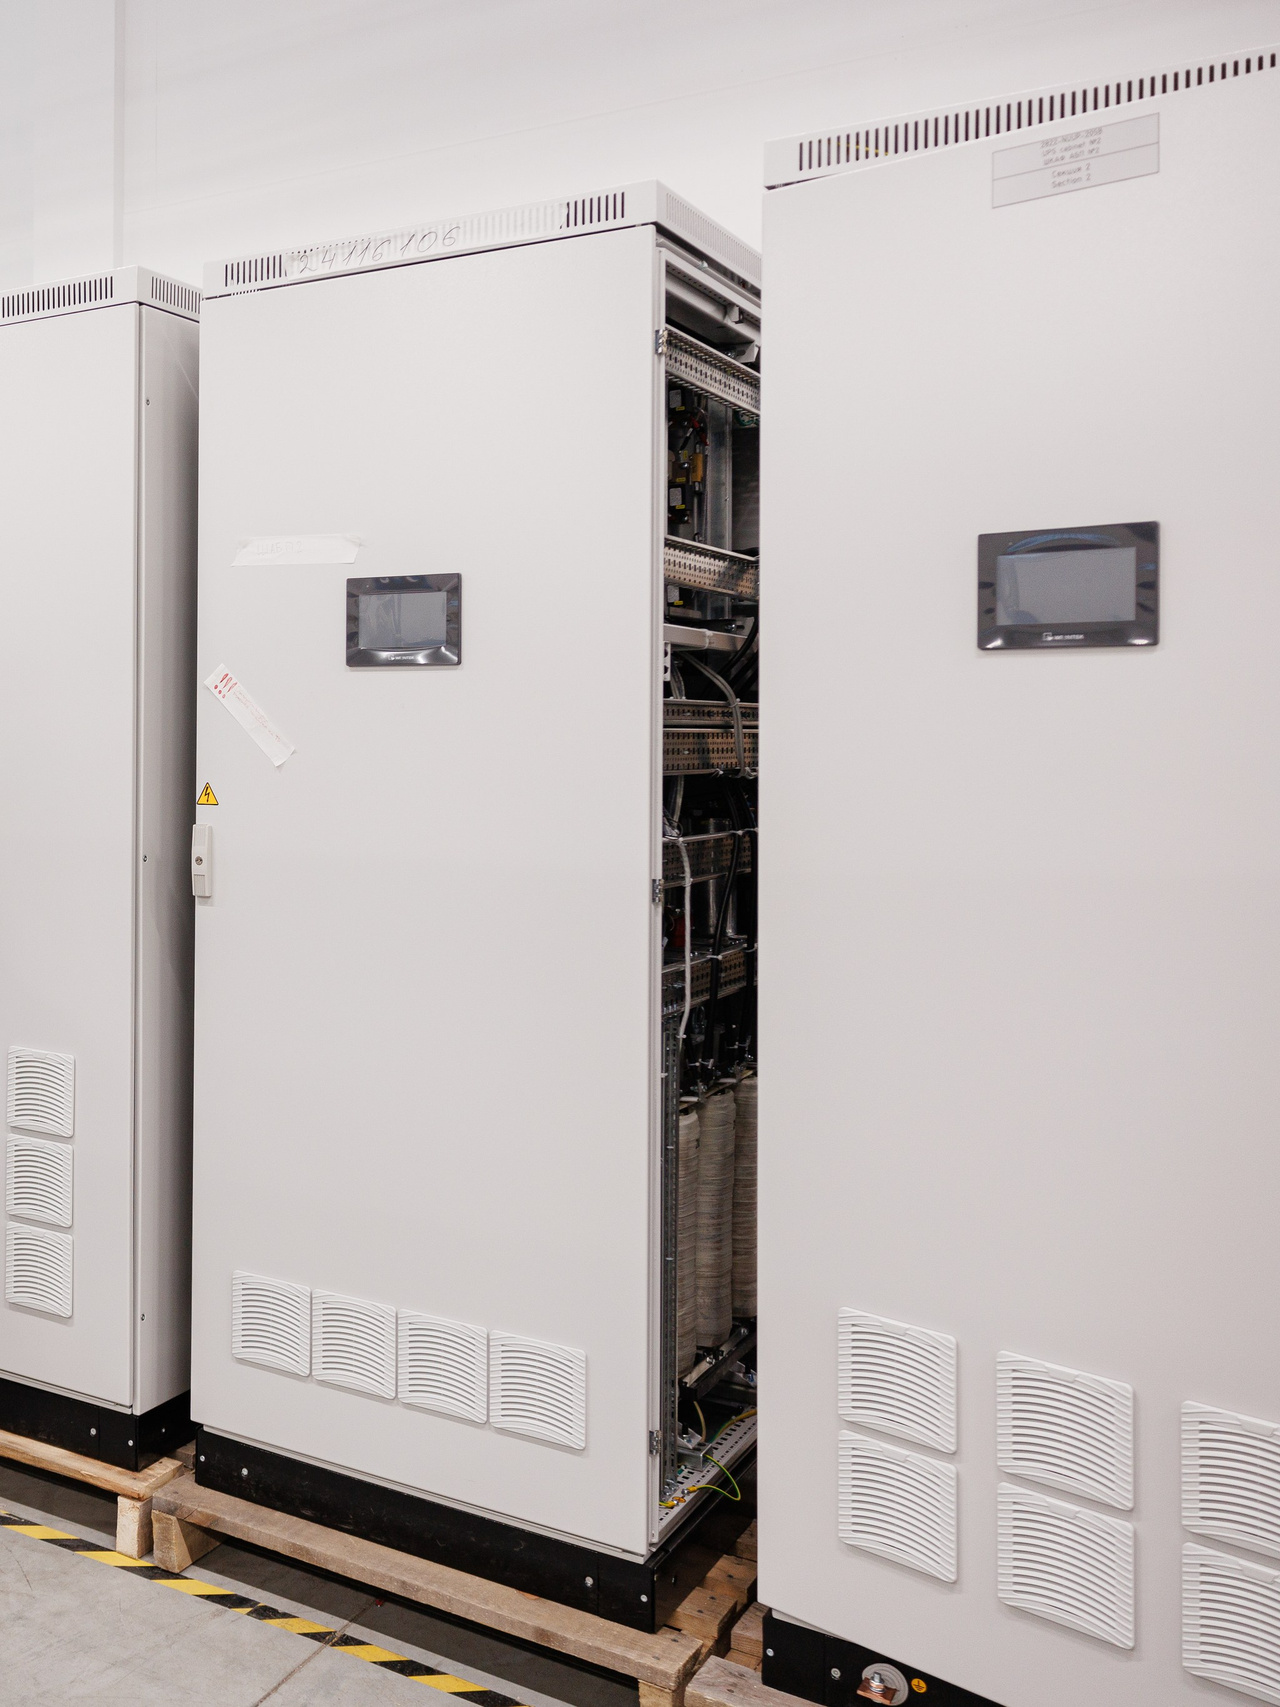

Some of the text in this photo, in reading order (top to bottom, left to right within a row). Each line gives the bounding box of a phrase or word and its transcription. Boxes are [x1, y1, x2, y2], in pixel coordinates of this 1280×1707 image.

[1085, 162, 1091, 171] 2
[1051, 173, 1091, 188] Section 2
